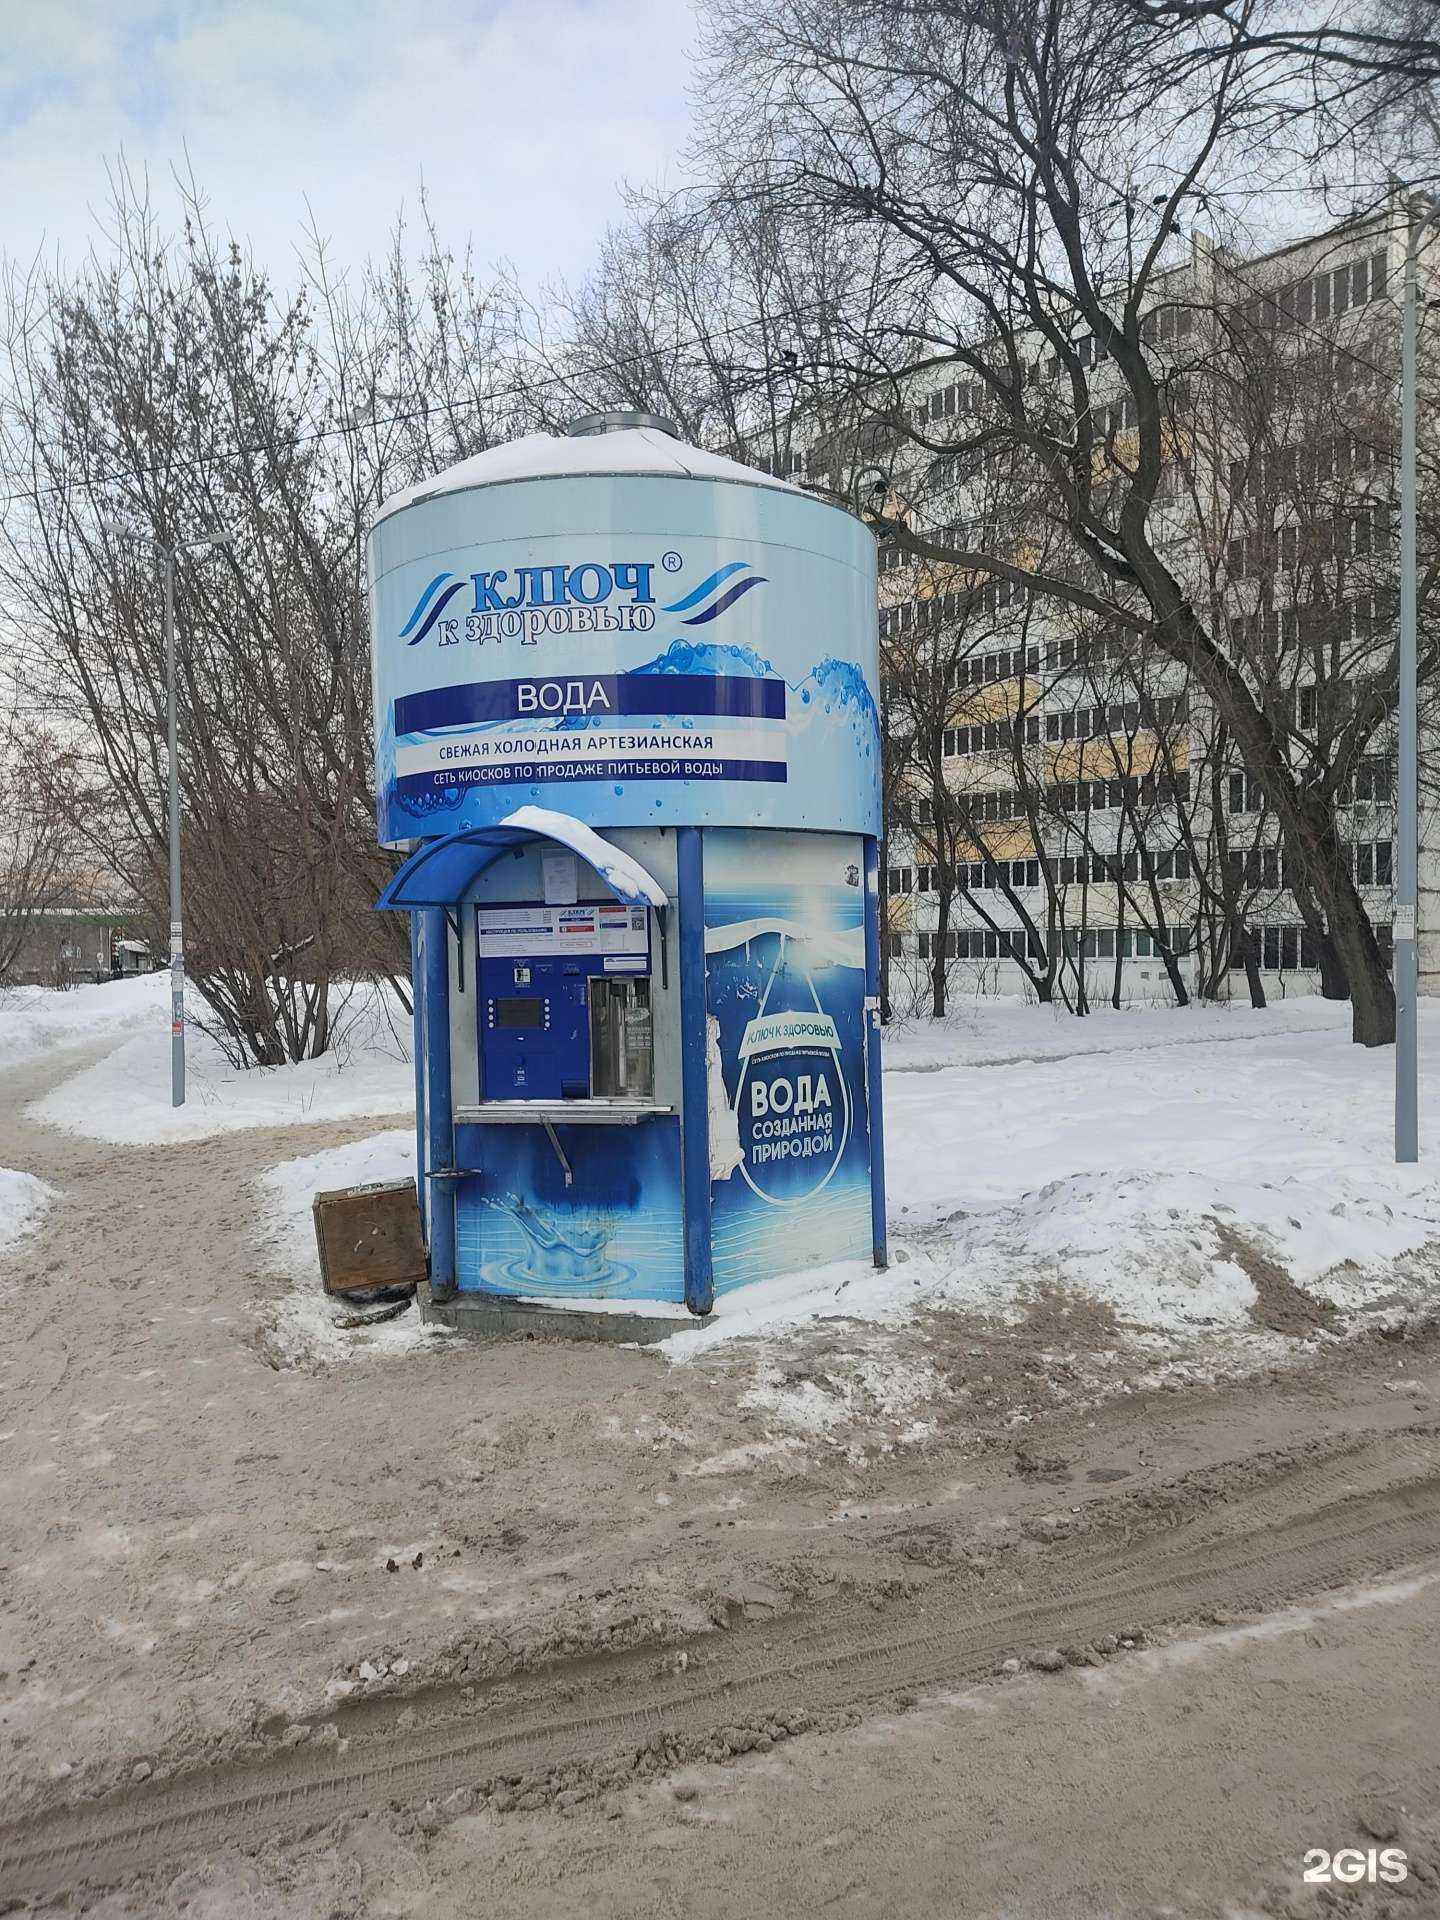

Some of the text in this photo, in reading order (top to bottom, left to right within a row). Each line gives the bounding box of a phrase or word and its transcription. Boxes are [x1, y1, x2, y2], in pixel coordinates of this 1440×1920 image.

[471, 563, 656, 613] КЛЮЧ
[517, 681, 611, 715] ВОДА
[439, 735, 713, 760] СВЕЖАЯ ХОЛОДНАЯ АРТЕЗИАНСКАЯ
[433, 760, 723, 785] СЕТЬ КИОСКОВ ПО ПРОДАЖЕ ПИТЬЕВОЙ ВОДЫ
[784, 1023, 834, 1038] ЗДОРОВЬЮ
[751, 1073, 832, 1117] ВОДА
[752, 1112, 833, 1140] СОЗДАННАЯ
[752, 1128, 833, 1164] ПРИРОДОЙ
